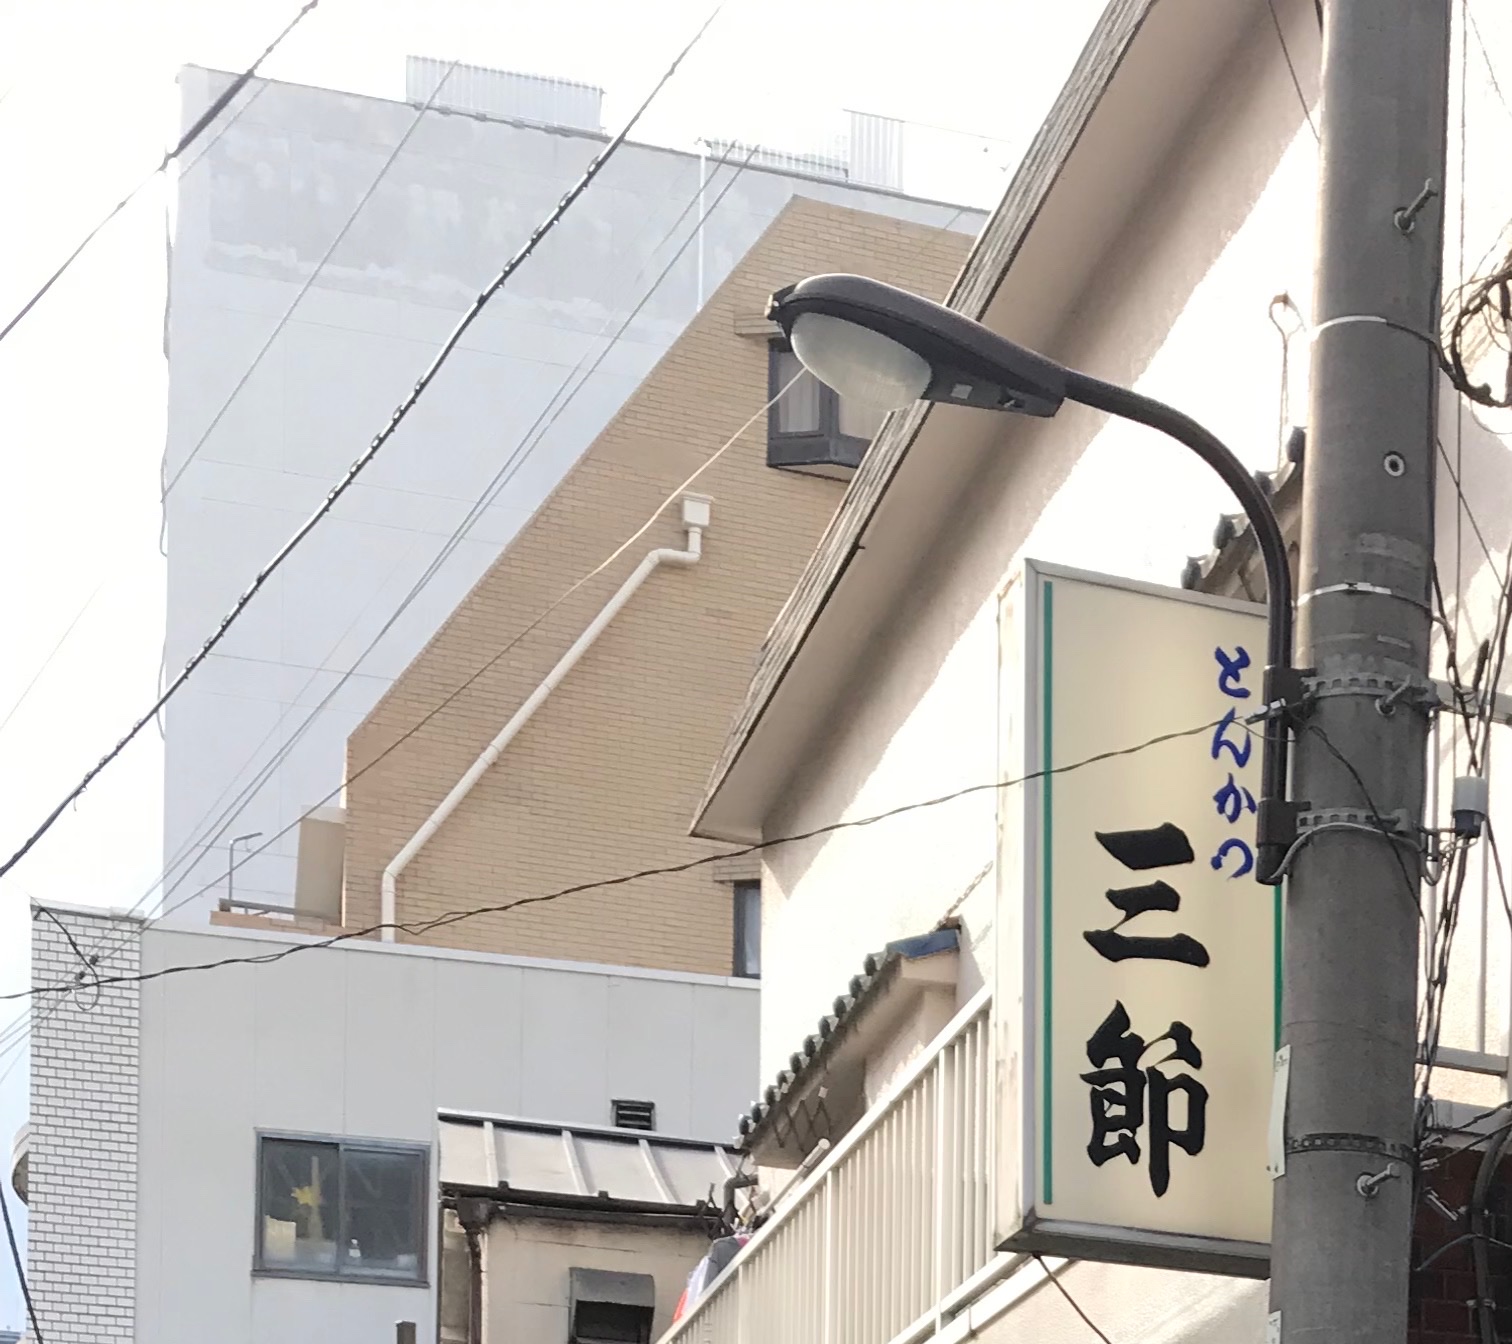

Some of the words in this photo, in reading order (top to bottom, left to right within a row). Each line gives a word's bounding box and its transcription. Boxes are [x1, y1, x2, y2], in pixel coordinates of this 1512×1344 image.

[1211, 645, 1257, 880] とんかつ
[1079, 821, 1210, 1198] 三節
